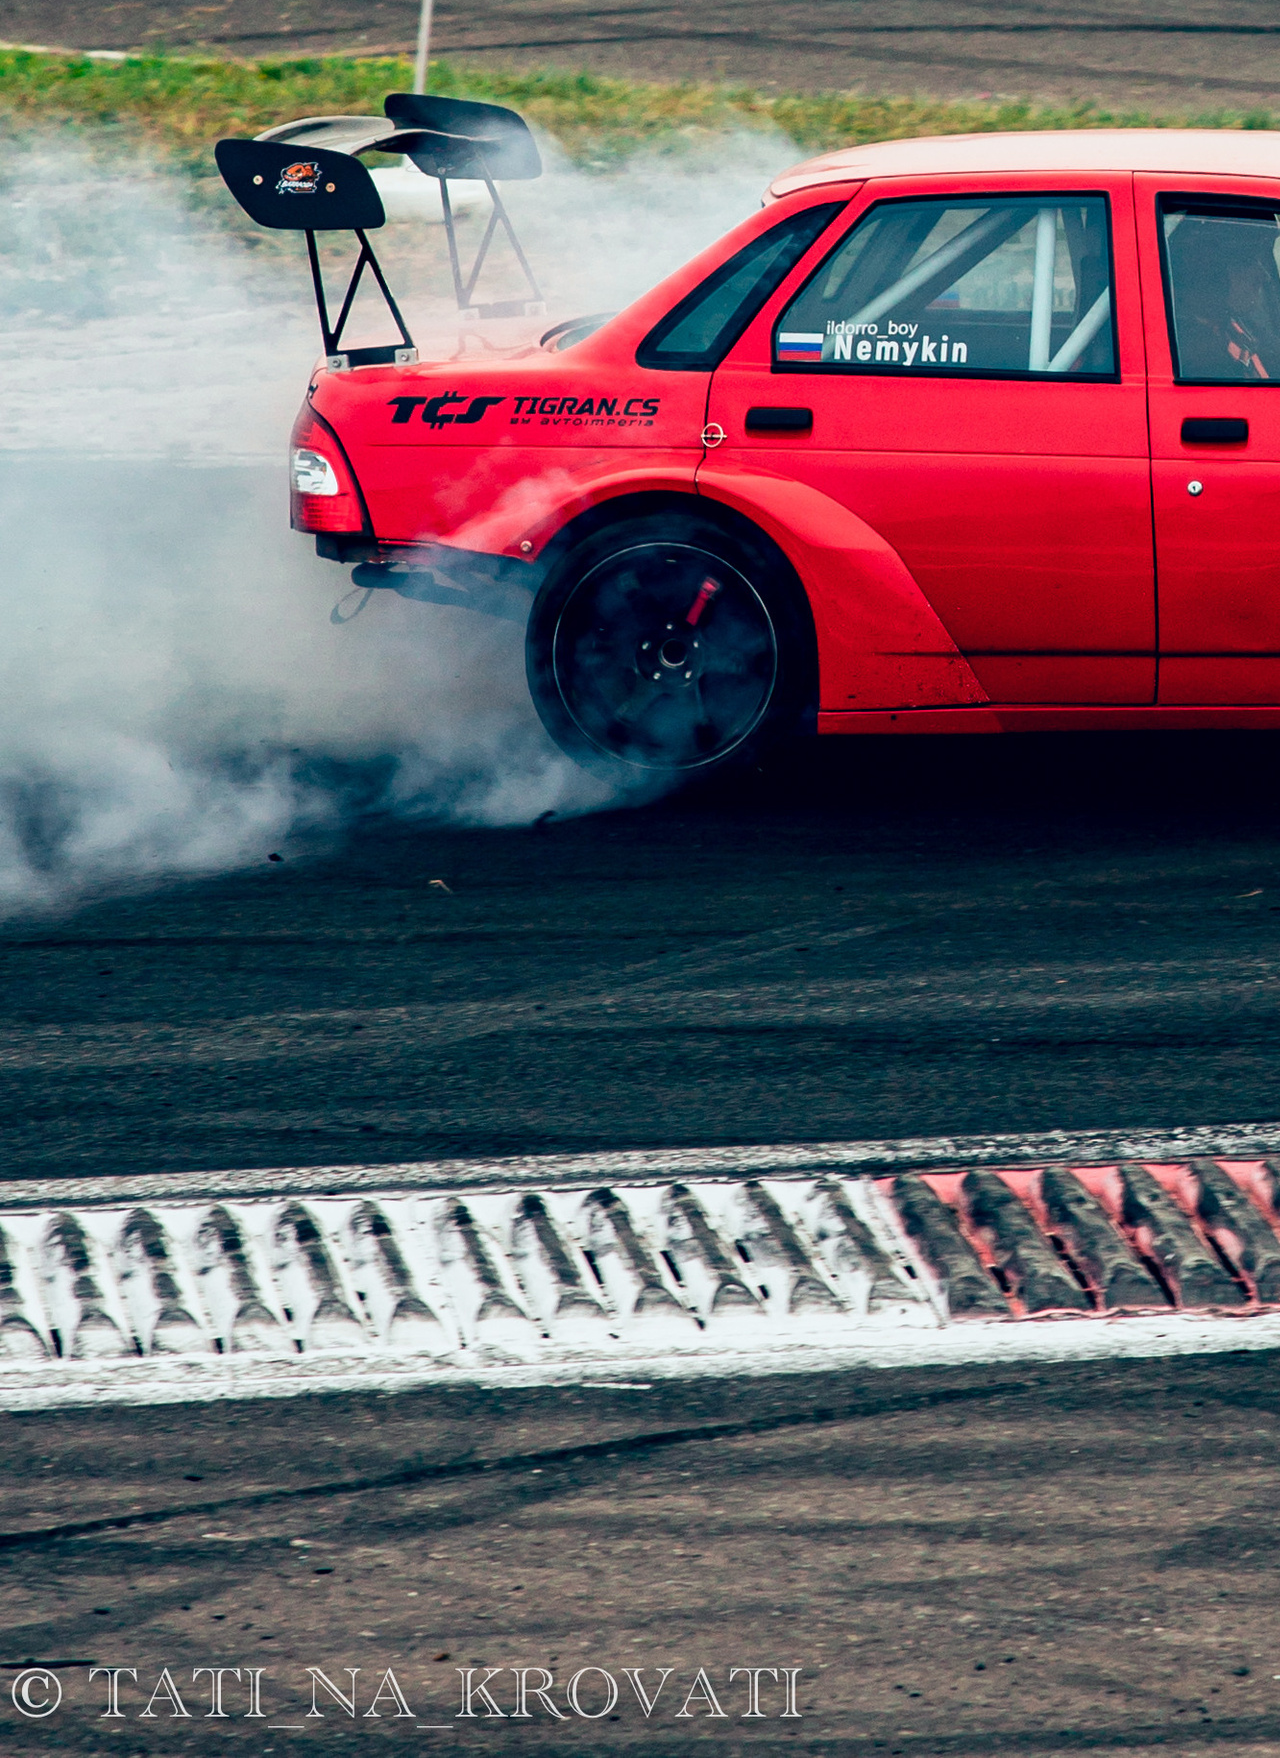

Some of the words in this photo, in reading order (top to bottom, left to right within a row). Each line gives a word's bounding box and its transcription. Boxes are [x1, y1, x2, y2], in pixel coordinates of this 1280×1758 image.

[826, 320, 919, 339] ildorro_boy
[833, 334, 968, 366] Nemykin
[513, 396, 661, 417] TIGRAN.CS
